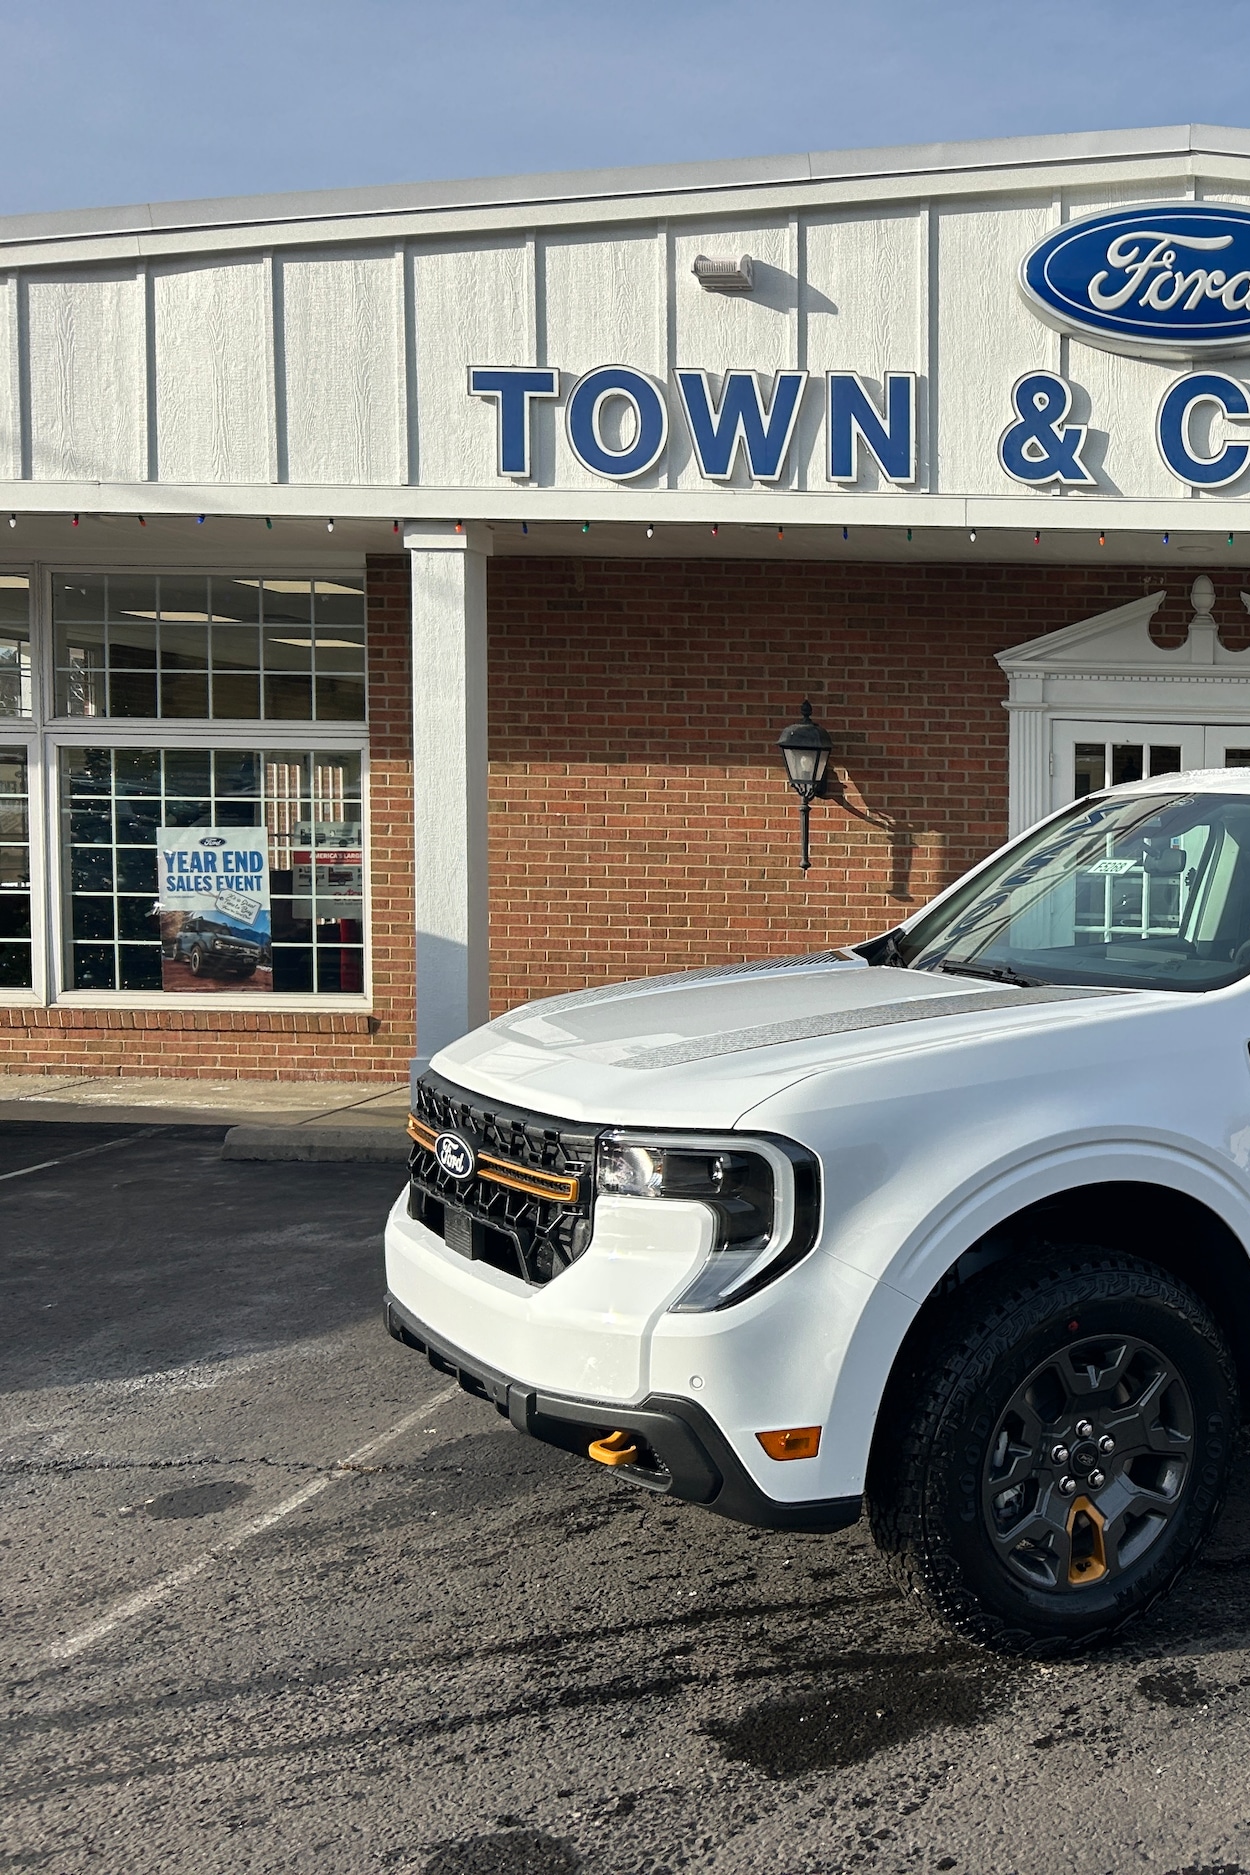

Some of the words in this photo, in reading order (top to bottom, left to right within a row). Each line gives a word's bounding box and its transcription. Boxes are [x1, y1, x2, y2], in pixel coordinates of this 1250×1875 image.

[467, 364, 917, 484] TOWN
[997, 369, 1098, 486] &
[163, 851, 217, 873] YEAR
[222, 851, 264, 873] END
[166, 875, 212, 892] SALES
[216, 875, 263, 891] EVENT
[440, 1137, 465, 1173] Ford
